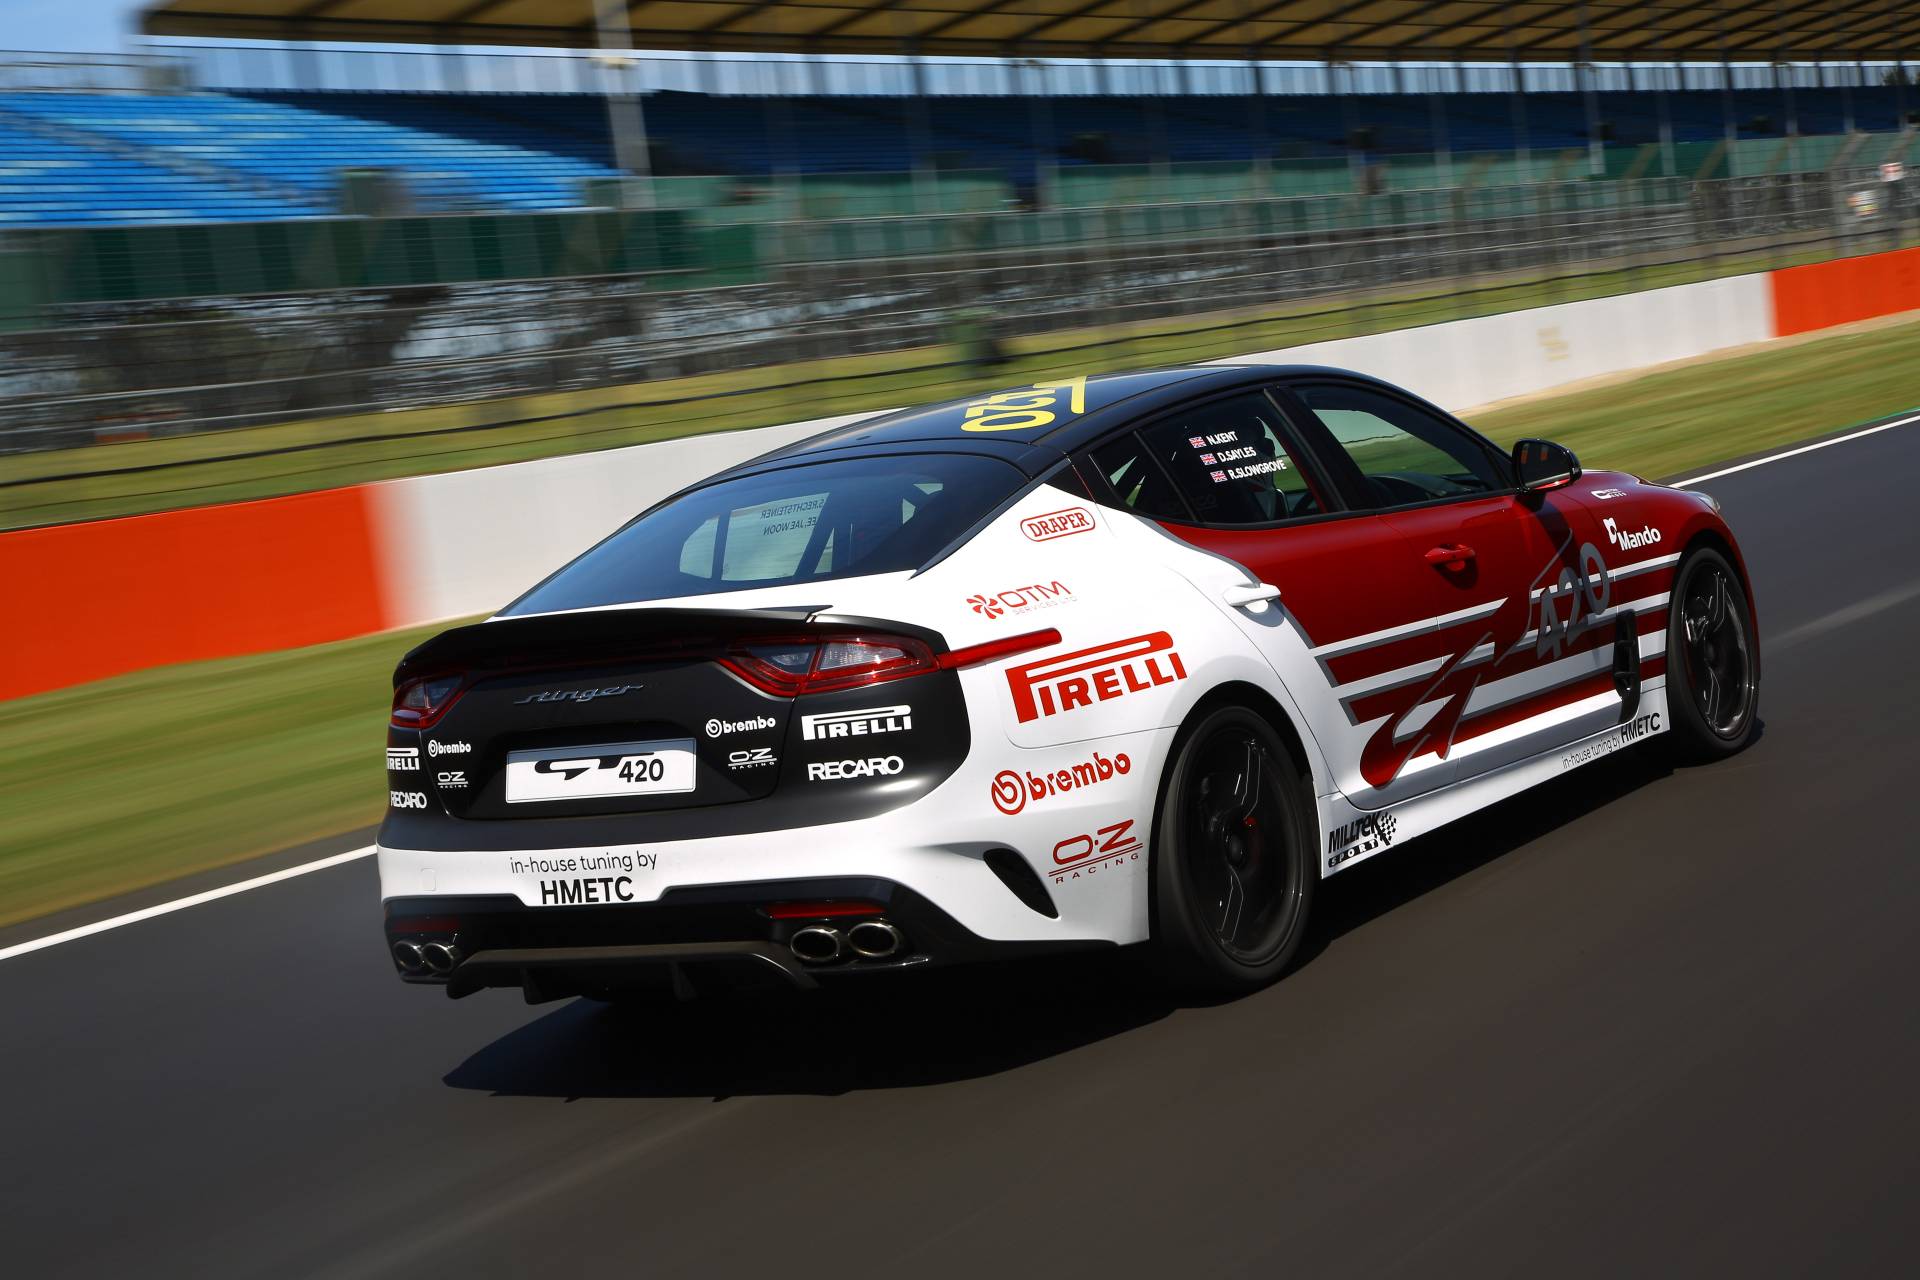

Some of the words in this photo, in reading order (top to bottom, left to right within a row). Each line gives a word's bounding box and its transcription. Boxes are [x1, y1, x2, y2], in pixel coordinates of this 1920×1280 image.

[1206, 431, 1238, 445] N.KENT
[1217, 446, 1257, 462] D.SAYLES
[1228, 460, 1287, 479] R.SLOWGROVE
[1027, 510, 1090, 538] DRAPER
[1617, 525, 1661, 551] Mando
[997, 581, 1071, 607] OTM
[1536, 542, 1610, 660] 420
[1005, 631, 1188, 723] PIRELLI
[722, 716, 777, 735] brembo
[801, 704, 912, 741] PIRELLI
[437, 740, 471, 754] brembo
[1562, 748, 1592, 769] in-house
[1591, 738, 1614, 753] tuning
[1612, 734, 1621, 747] by
[1620, 712, 1661, 743] HMETC
[618, 758, 664, 783] 420
[808, 755, 904, 781] RECARO
[1026, 751, 1132, 800] brembo
[390, 790, 427, 809] RECARO
[510, 856, 577, 874] in-house
[580, 852, 633, 872] tuning
[637, 850, 657, 870] by
[1331, 839, 1377, 866] SPORT
[1055, 852, 1140, 884] RACING
[540, 876, 634, 905] HMETC
